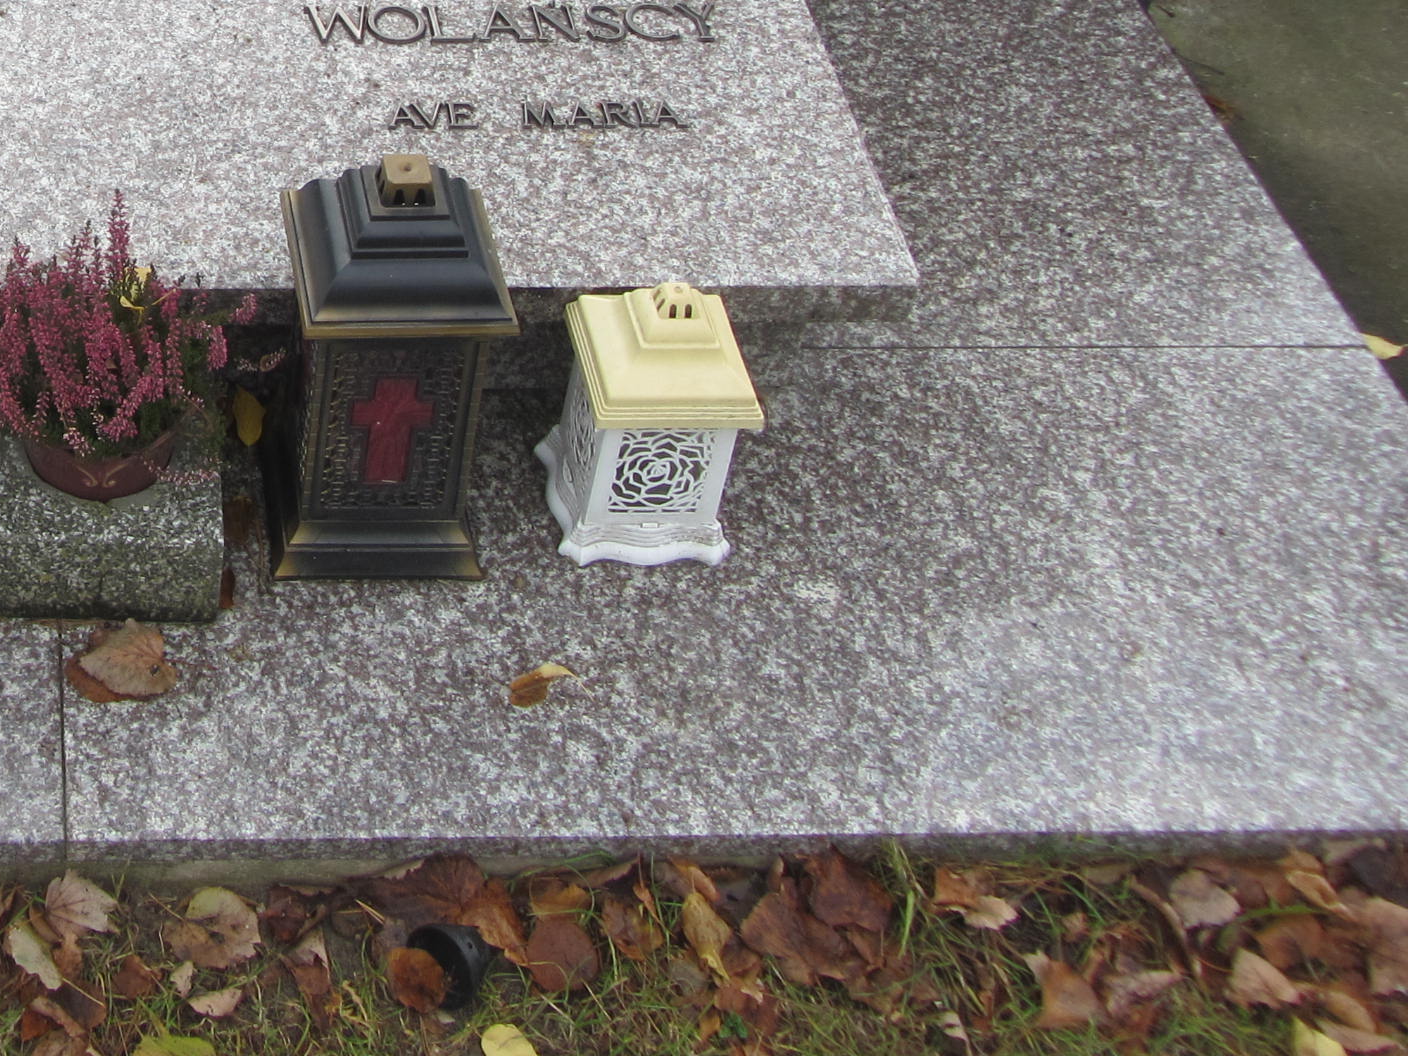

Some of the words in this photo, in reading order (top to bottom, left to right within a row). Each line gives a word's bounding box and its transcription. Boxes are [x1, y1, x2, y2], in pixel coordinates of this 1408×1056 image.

[303, 0, 717, 45] WOLAŃSCY
[389, 101, 479, 130] AVE
[521, 100, 690, 130] MARIA
